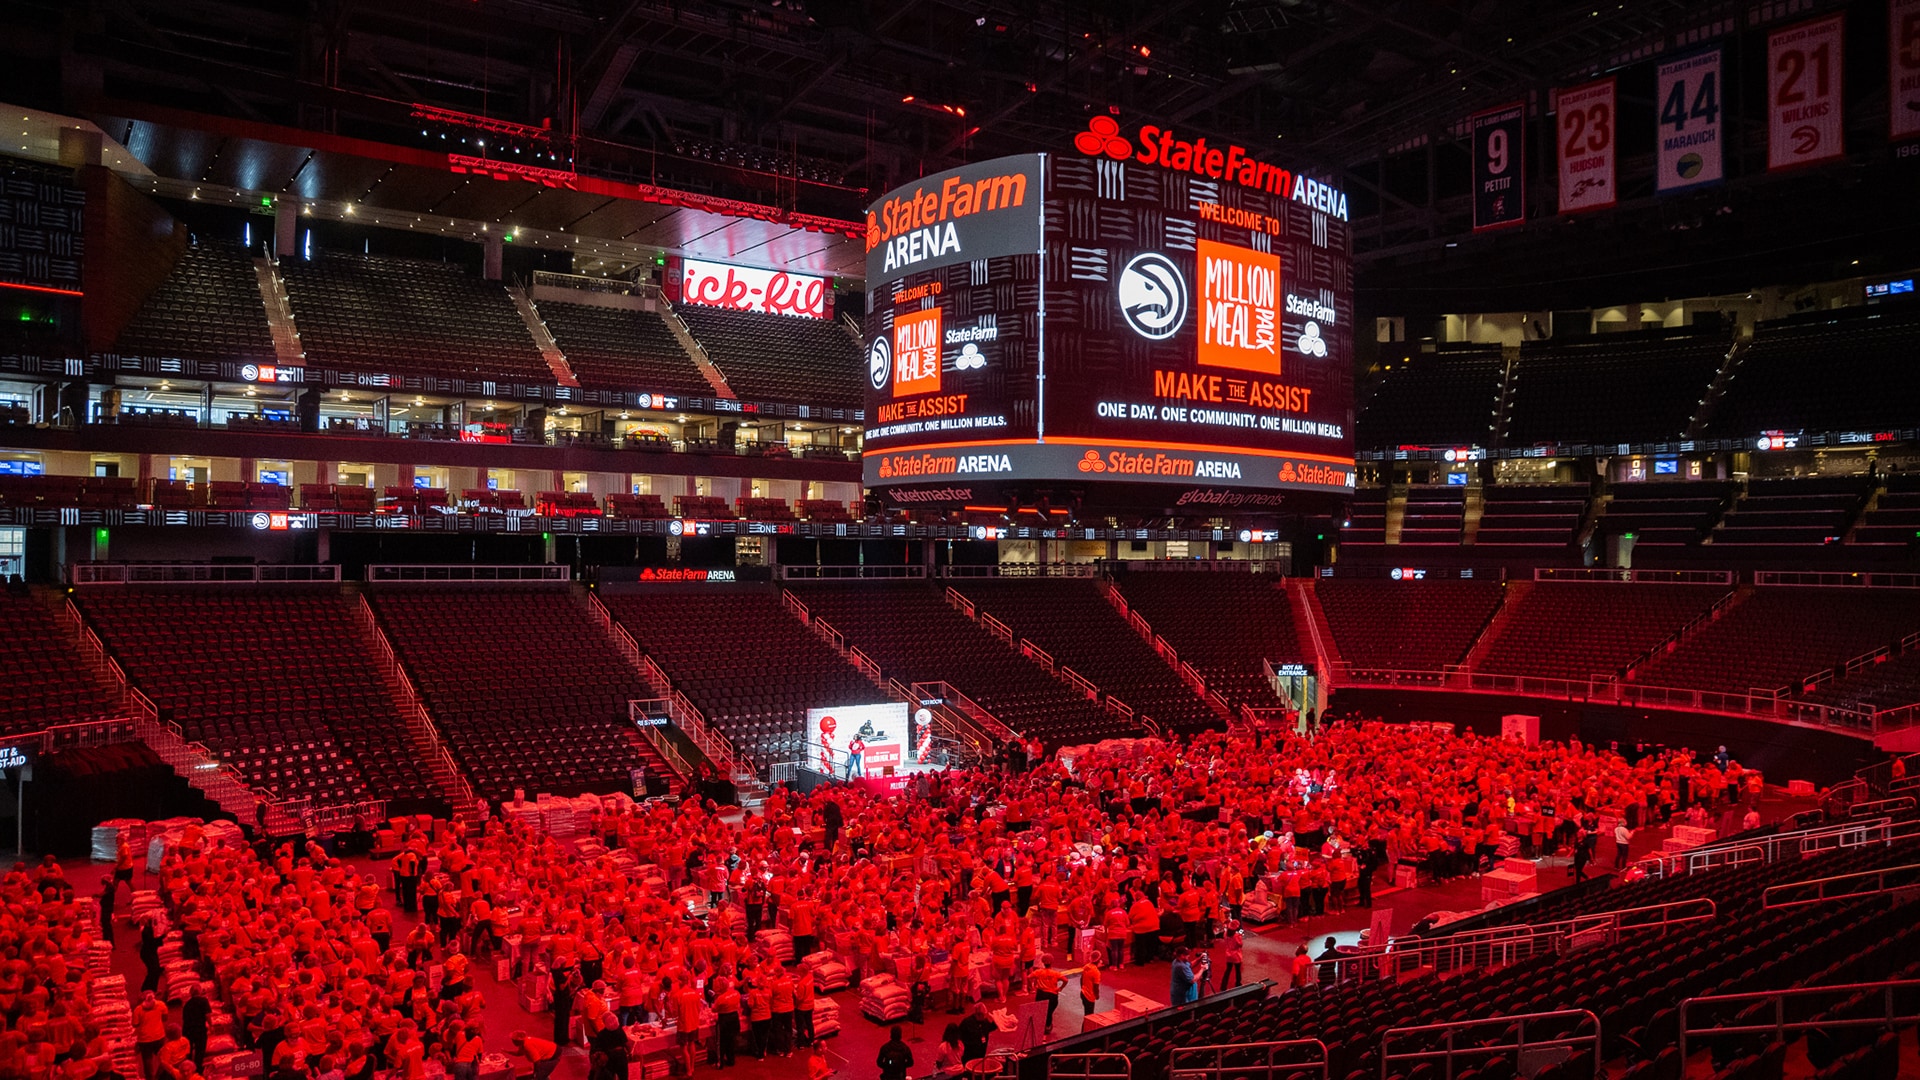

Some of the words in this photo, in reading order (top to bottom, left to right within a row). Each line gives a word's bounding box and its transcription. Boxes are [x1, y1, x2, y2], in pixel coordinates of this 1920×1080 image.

[1772, 31, 1806, 46] ATLANTA
[1808, 23, 1837, 36] HAWKS
[1778, 42, 1828, 106] 21
[1662, 72, 1718, 131] 44
[1782, 102, 1829, 124] WILKINS
[1564, 104, 1609, 158] 23
[1664, 129, 1715, 151] MARAVICH
[1488, 128, 1508, 174] 9
[1570, 156, 1605, 174] HUDSON
[1292, 174, 1348, 222] ARENA
[1484, 176, 1512, 192] PETTIT
[1198, 201, 1262, 232] WELCOME
[1265, 216, 1280, 236] TO
[884, 222, 961, 273] ARENA
[895, 284, 928, 304] WELCOME
[930, 282, 942, 294] TO
[1205, 256, 1274, 308] MILLION
[897, 318, 936, 354] MILLION
[1205, 300, 1256, 349] MEAL
[1255, 308, 1274, 354] PACK
[897, 350, 924, 383] MEAL
[922, 348, 936, 378] PACK
[1154, 370, 1222, 402] MAKE
[1229, 384, 1245, 398] THE
[1249, 381, 1311, 413] ASSIST
[726, 404, 741, 412] ONE
[878, 402, 904, 423] MAKE
[907, 405, 916, 414] THE
[918, 394, 968, 416] ASSIST
[1098, 402, 1126, 418] ONE
[1130, 404, 1158, 420] DAY.
[1161, 406, 1187, 422] ONE
[1190, 410, 1258, 428] COMMUNITY.
[1260, 416, 1280, 431] ONE
[1282, 418, 1316, 436] MILLION
[1318, 422, 1344, 439] MEALS.
[890, 422, 924, 435] COMMUNITY.
[925, 421, 940, 430] ONE
[941, 418, 973, 429] MILLION
[975, 416, 1007, 427] MEALS.
[1852, 434, 1872, 442] ONE
[957, 454, 1012, 473] ARENA
[1196, 461, 1241, 478] ARENA
[889, 488, 972, 502] ticketmaster
[708, 570, 735, 580] ARENA
[10, 746, 18, 756] &
